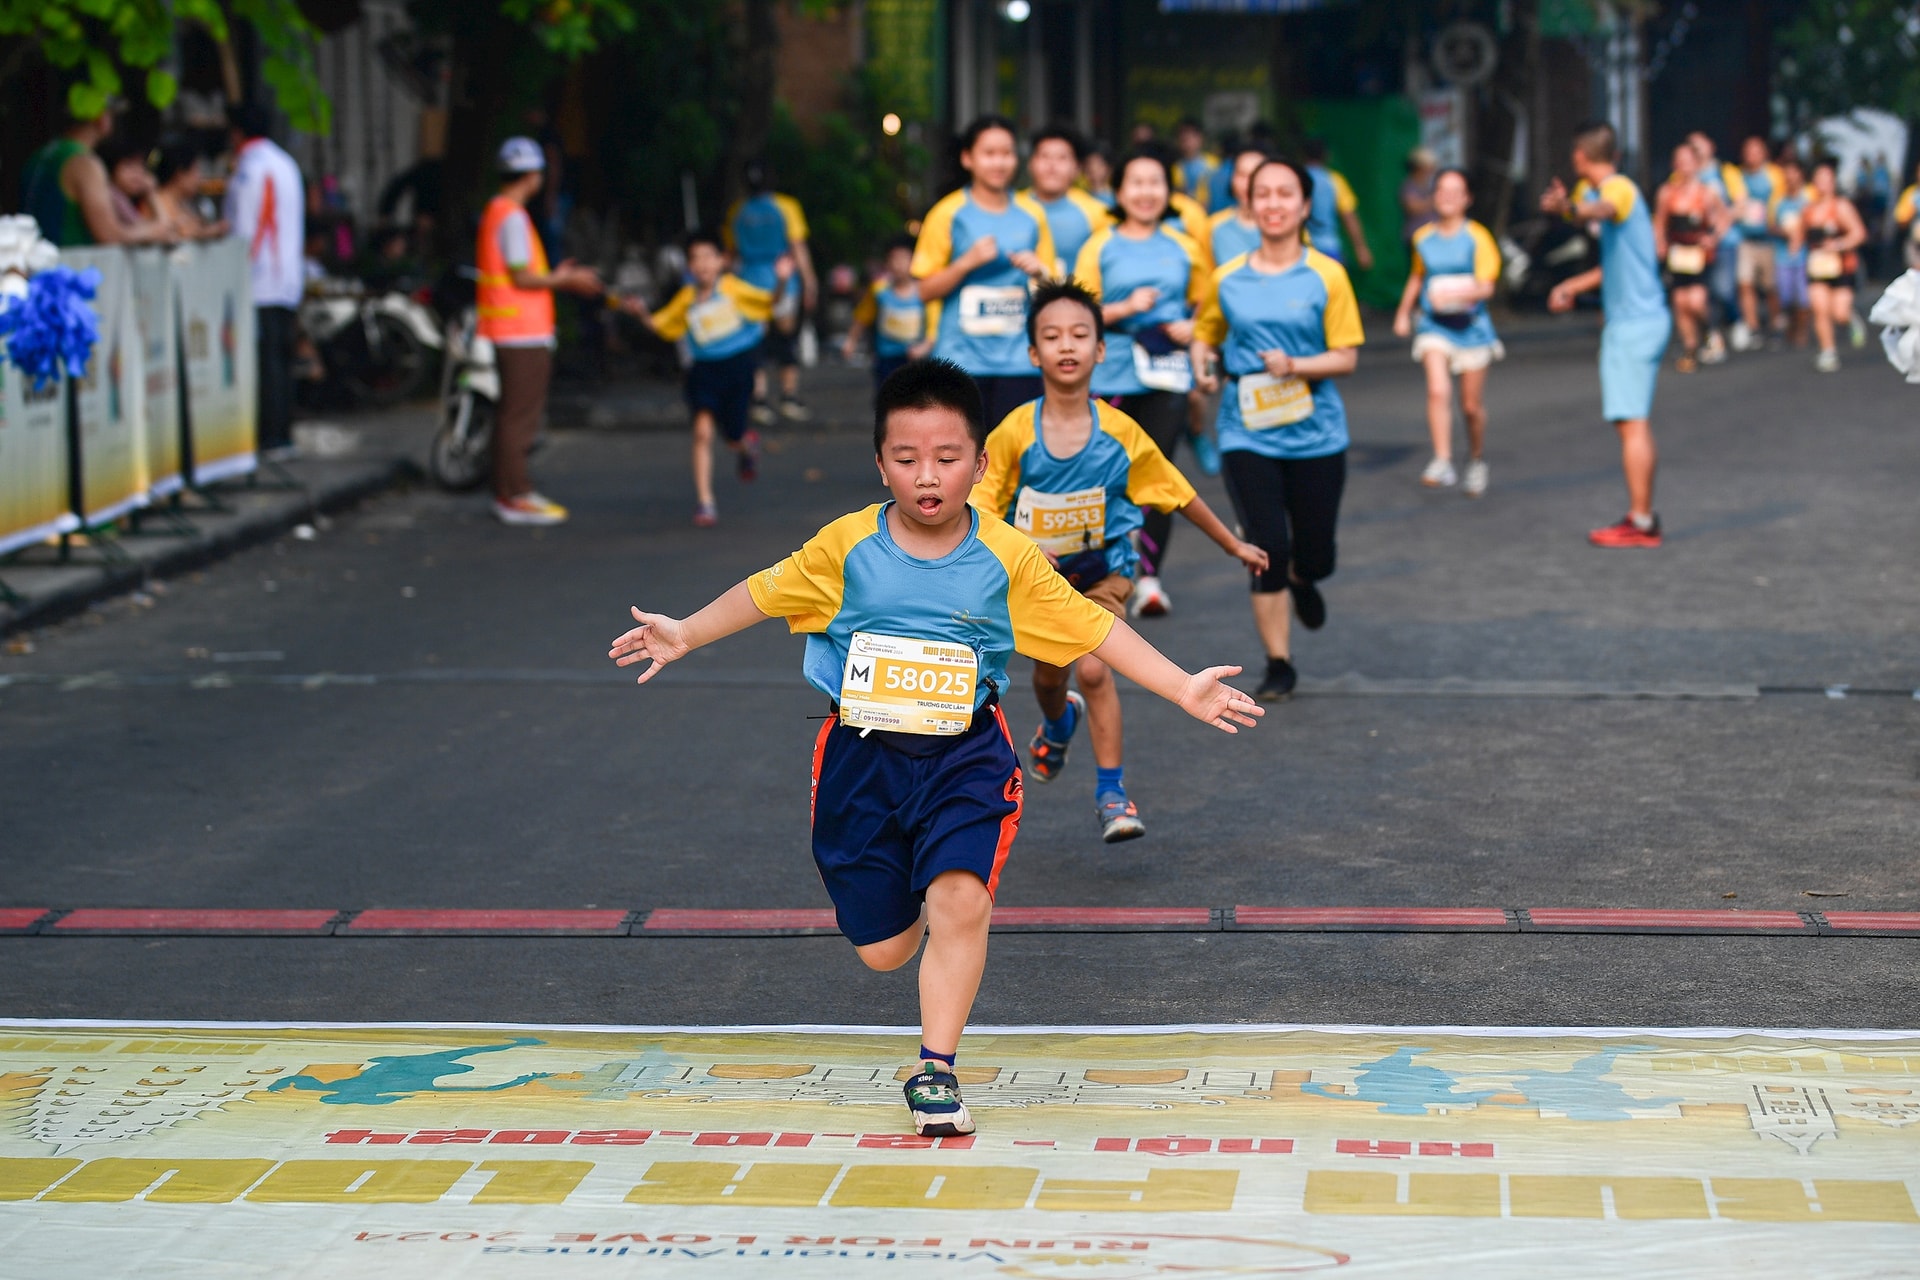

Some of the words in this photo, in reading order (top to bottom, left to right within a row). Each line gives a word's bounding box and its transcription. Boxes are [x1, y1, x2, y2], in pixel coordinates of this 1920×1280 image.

[1042, 508, 1101, 530] 59533
[850, 663, 870, 683] M
[885, 664, 970, 697] 58025
[624, 1161, 1238, 1213] FOR
[351, 1231, 524, 1243] 2024
[548, 1232, 758, 1245] LOVE
[784, 1235, 944, 1247] FOR
[969, 1238, 1150, 1250] RUN
